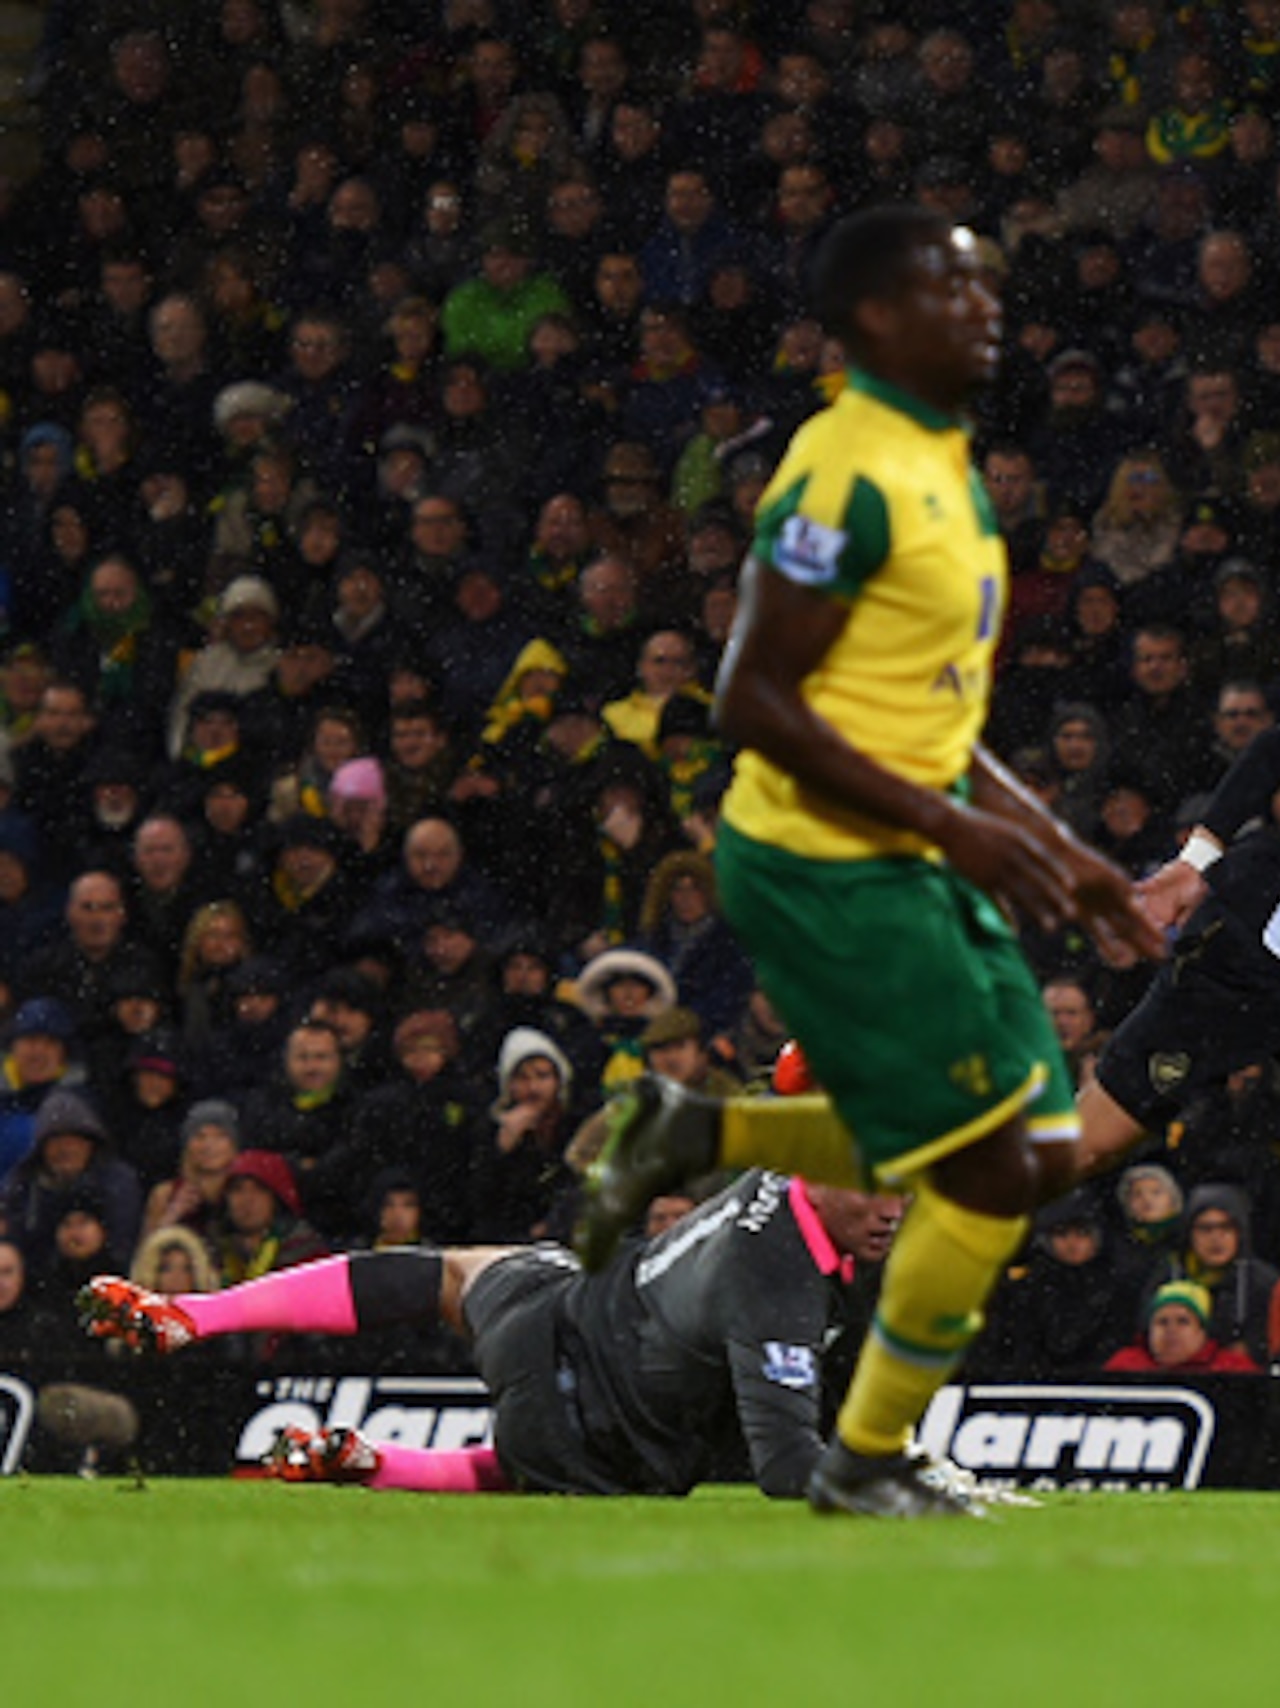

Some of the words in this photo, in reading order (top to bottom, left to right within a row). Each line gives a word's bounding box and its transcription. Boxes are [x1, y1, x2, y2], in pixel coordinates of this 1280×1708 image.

[234, 1377, 497, 1461] alar
[275, 1377, 334, 1402] THE
[917, 1386, 1187, 1471] larm
